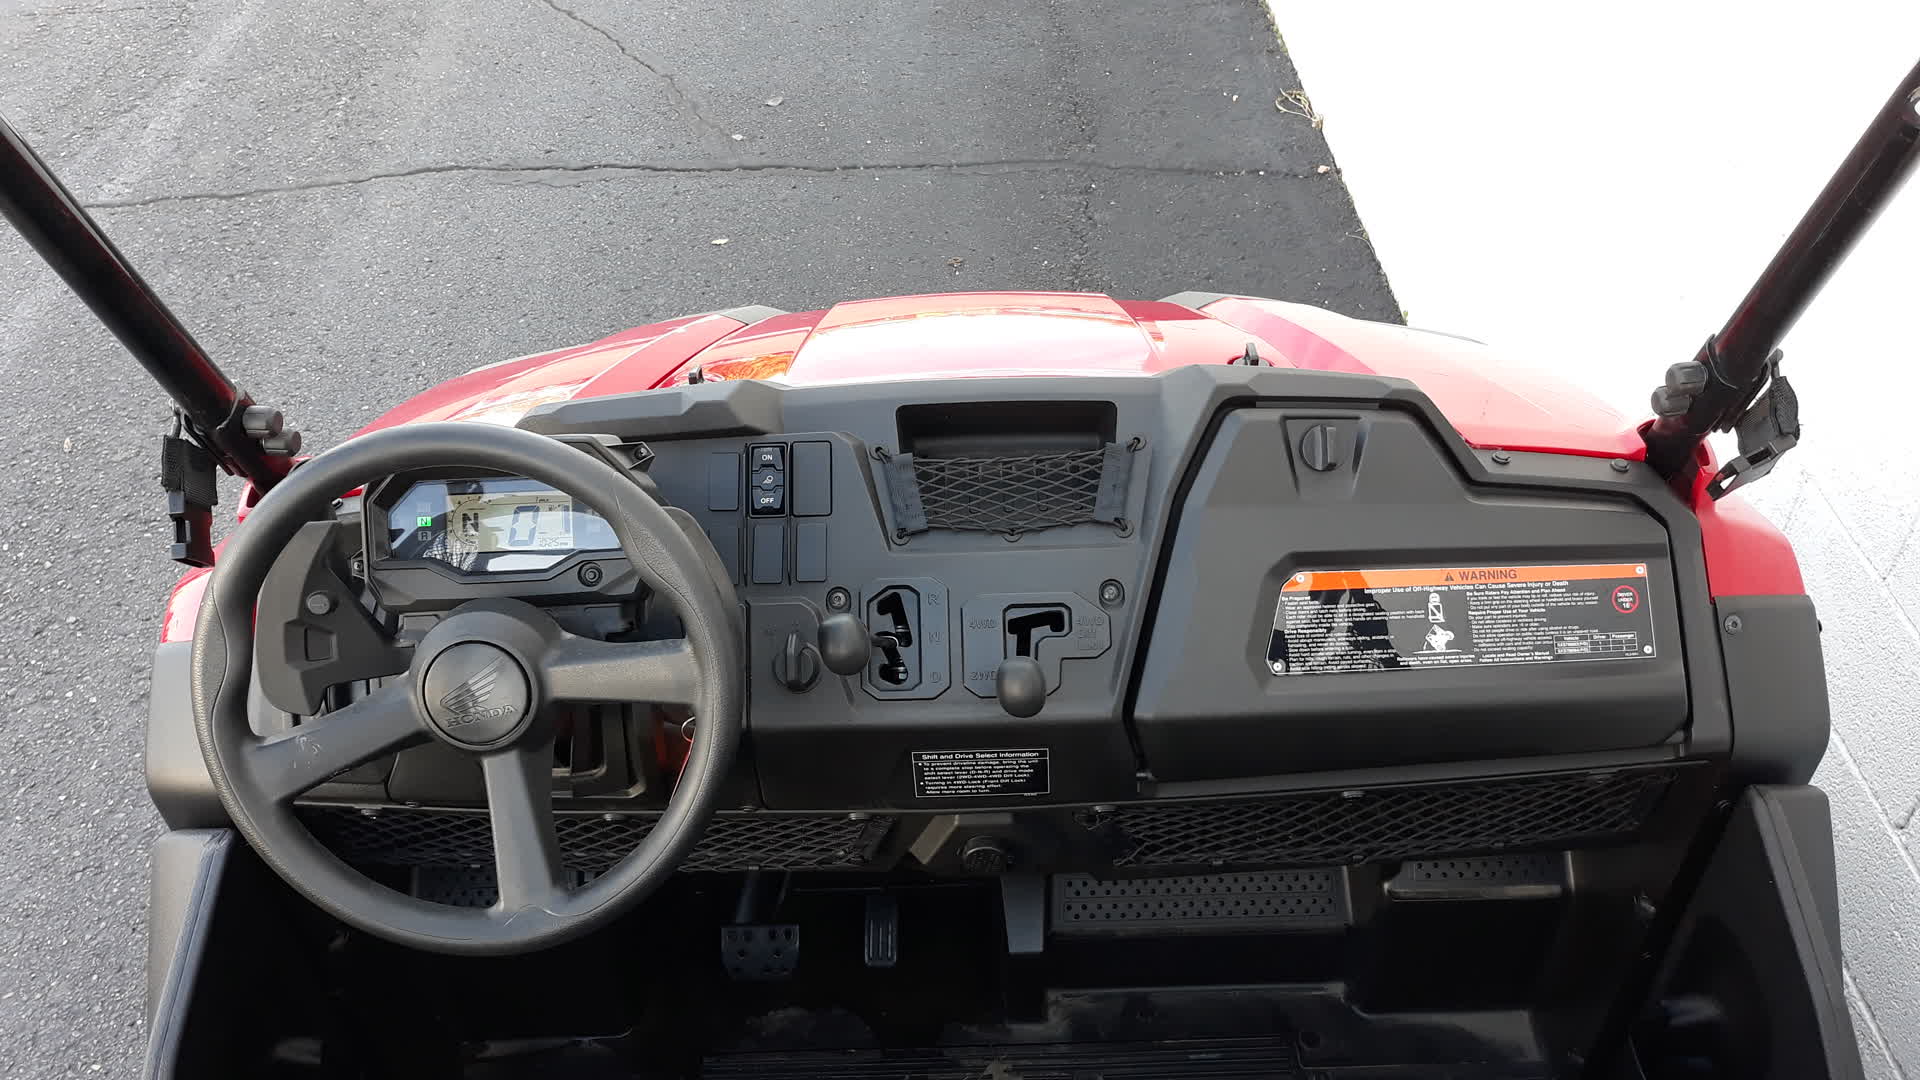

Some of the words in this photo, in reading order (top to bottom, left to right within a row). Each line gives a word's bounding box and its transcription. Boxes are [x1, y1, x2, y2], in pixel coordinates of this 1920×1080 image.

[420, 518, 428, 526] N
[421, 532, 428, 540] R
[1459, 570, 1518, 581] WARNING
[447, 704, 518, 728] HONDA
